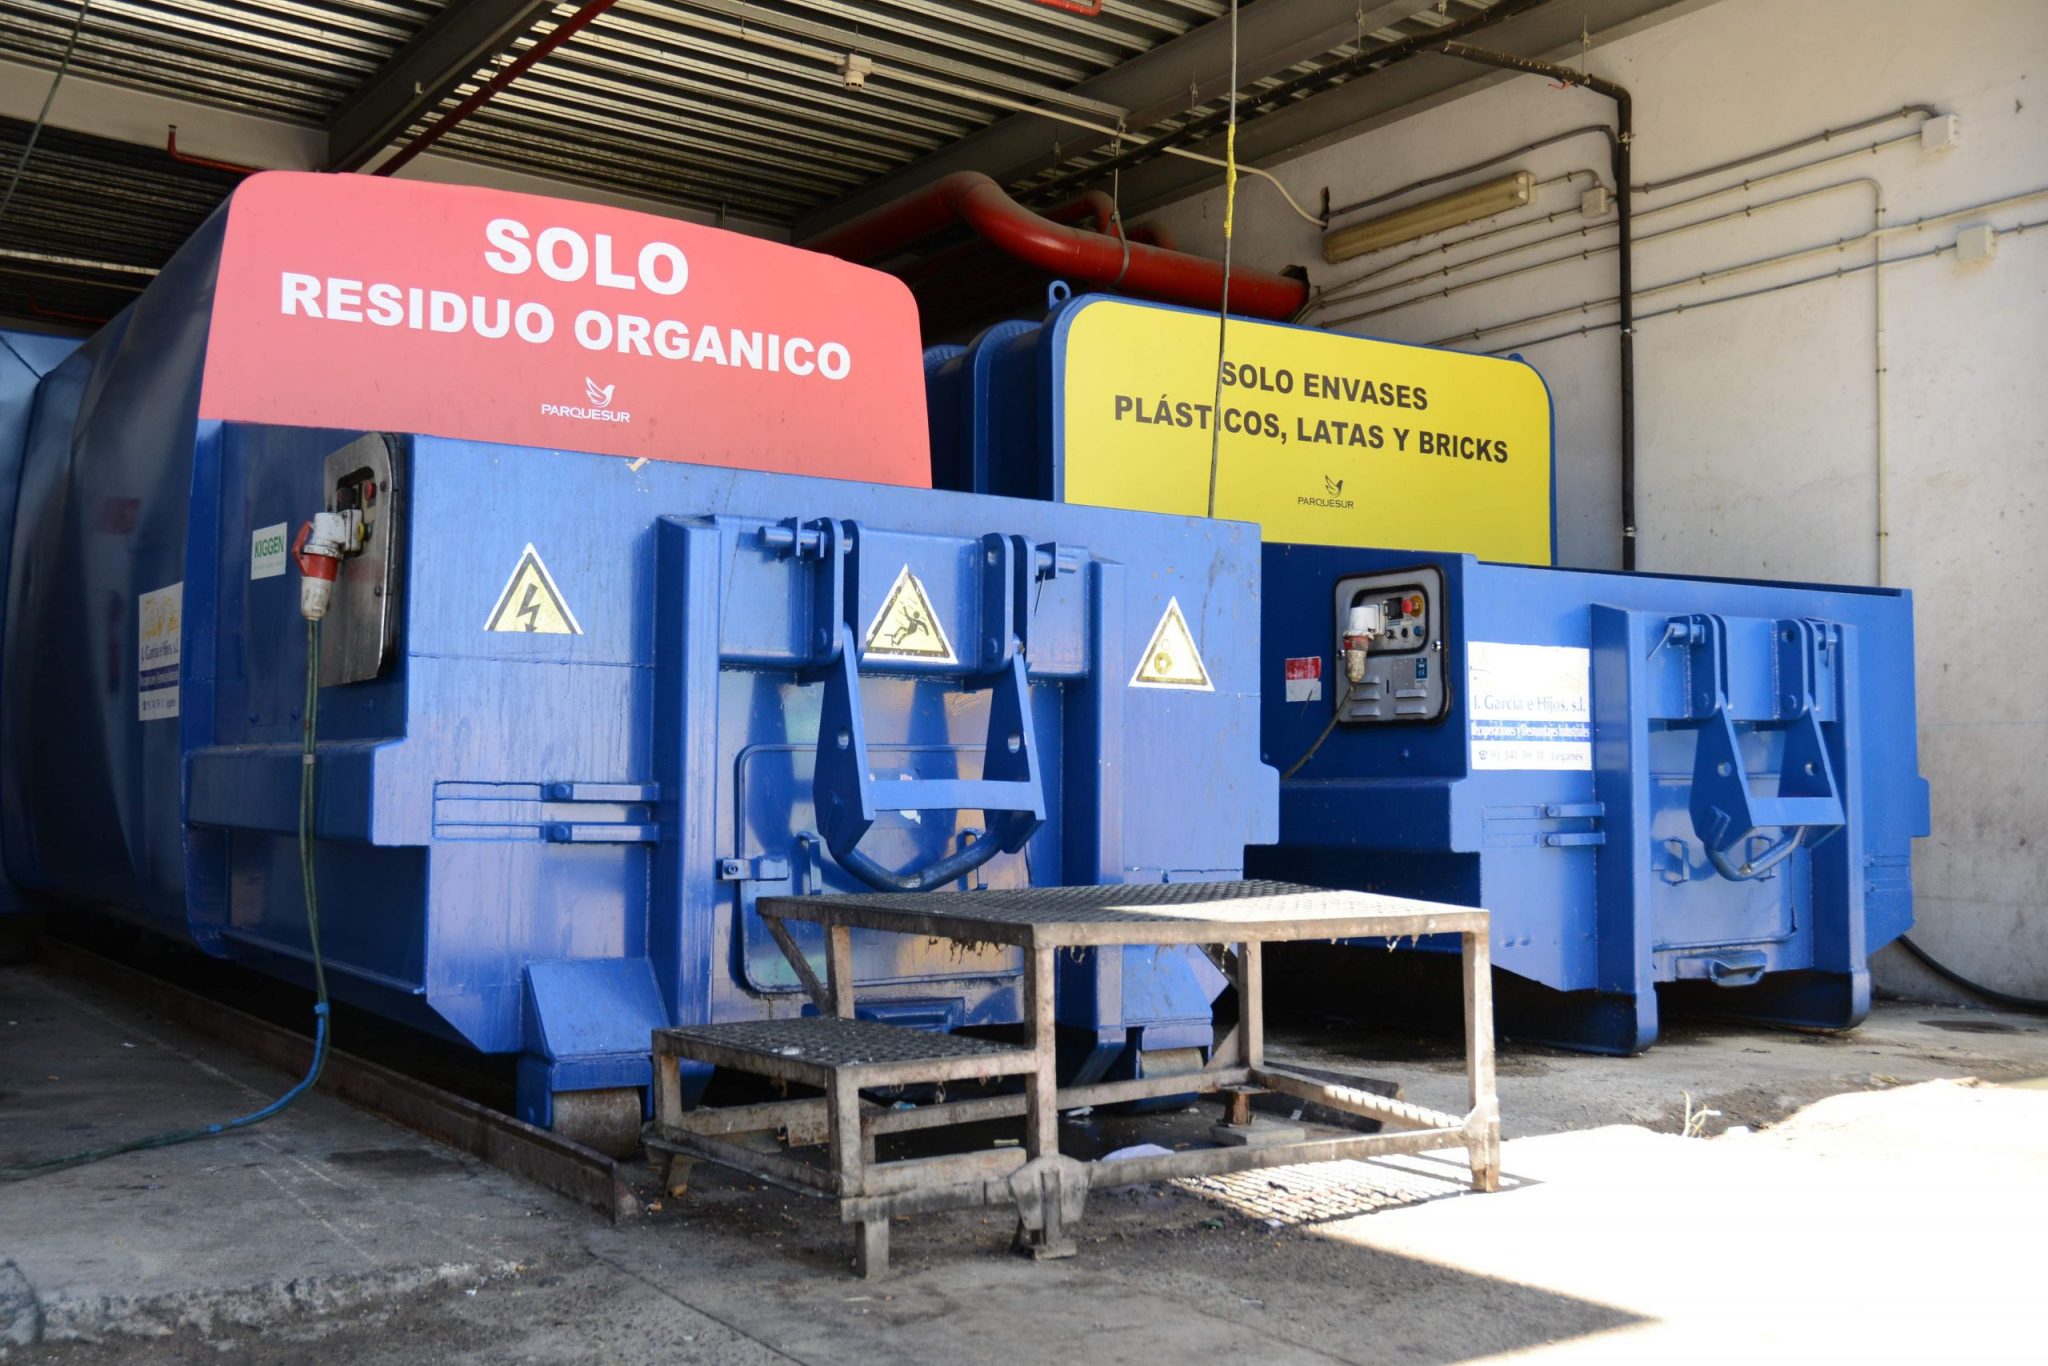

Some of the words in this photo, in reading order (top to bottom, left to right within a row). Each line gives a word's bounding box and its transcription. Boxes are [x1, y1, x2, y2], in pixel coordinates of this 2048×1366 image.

[484, 218, 689, 296] SOLO
[281, 271, 555, 345] RESIDUO
[574, 309, 851, 381] ORGANICO
[1221, 361, 1294, 394] SOLO
[1304, 372, 1428, 411] ENVASES
[540, 403, 631, 425] PARQUESUR
[1297, 417, 1384, 449] LATAS
[1392, 427, 1410, 452] Y
[1419, 430, 1508, 464] BRICKS
[1297, 496, 1354, 510] PARQUESUR
[255, 536, 284, 558] KIGGEN
[1527, 700, 1534, 711] e
